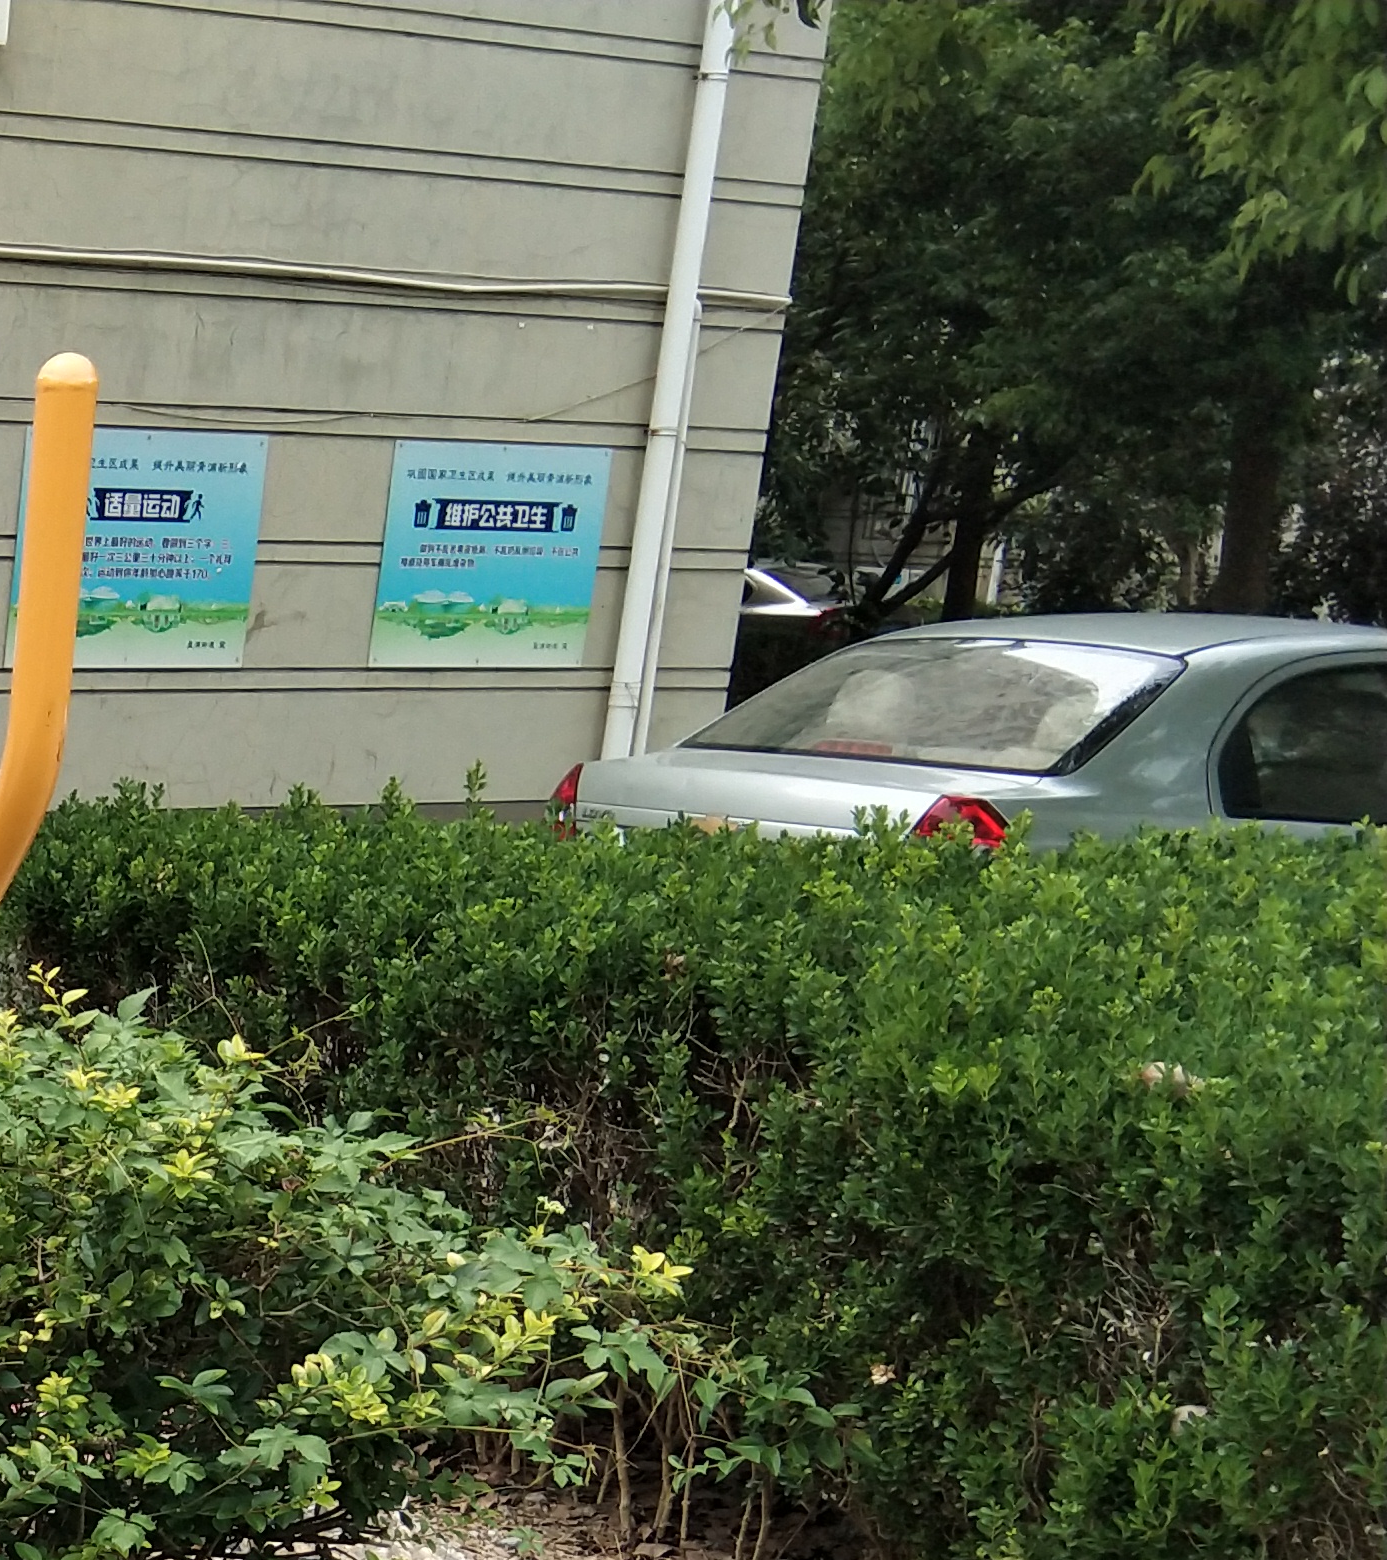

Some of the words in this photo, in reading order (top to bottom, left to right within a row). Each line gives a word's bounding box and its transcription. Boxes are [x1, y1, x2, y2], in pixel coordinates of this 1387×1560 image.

[103, 492, 181, 518] 适量运动
[444, 502, 548, 529] 维护公共卫生
